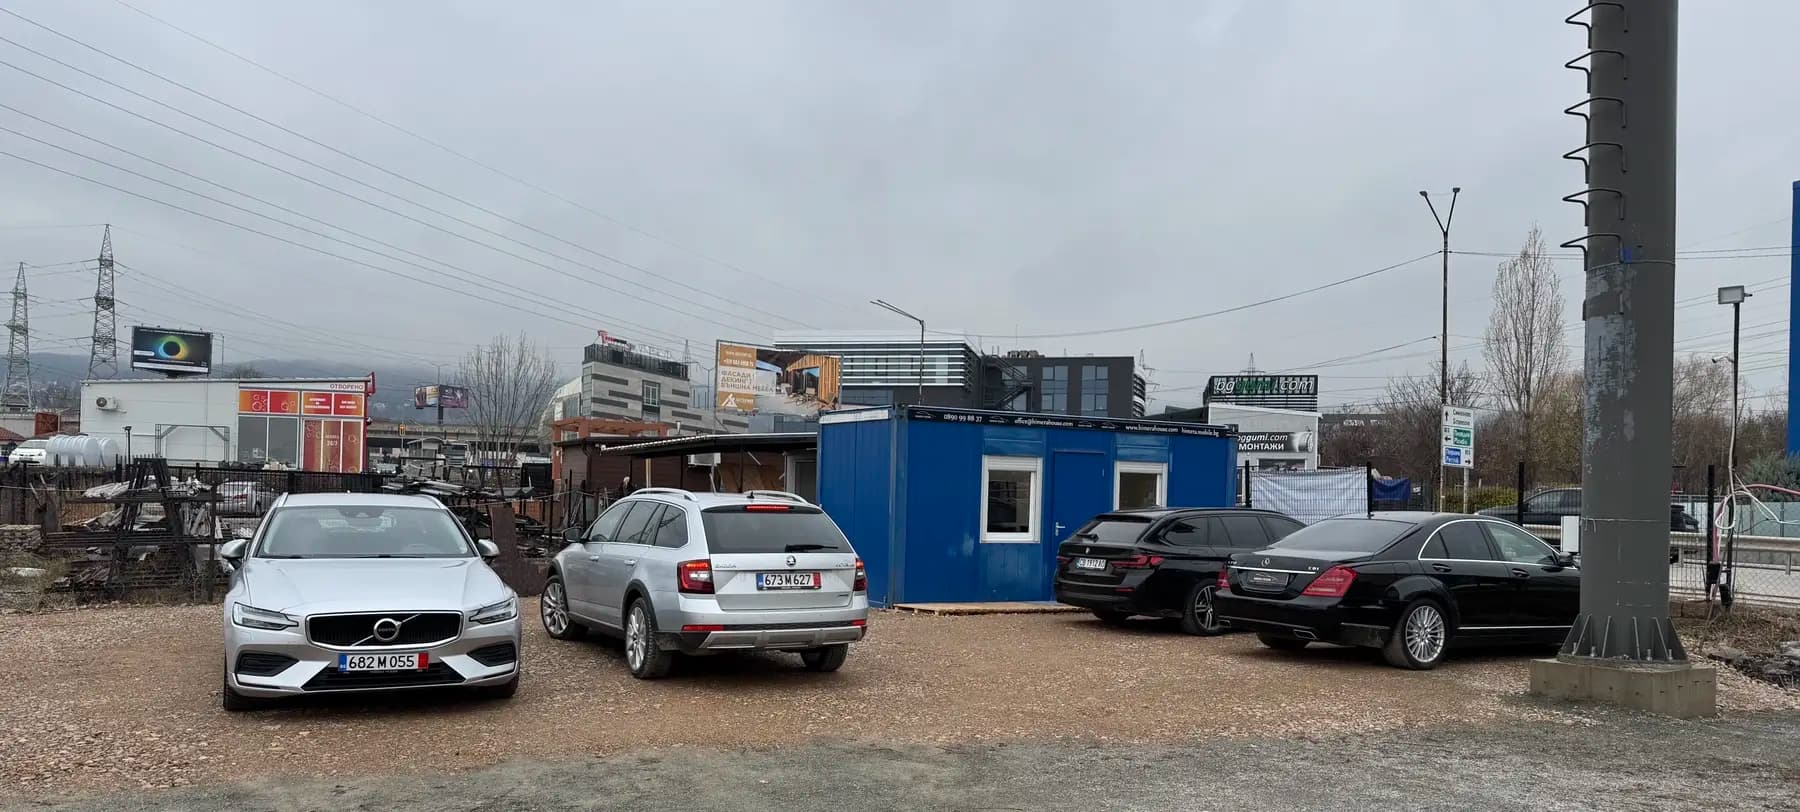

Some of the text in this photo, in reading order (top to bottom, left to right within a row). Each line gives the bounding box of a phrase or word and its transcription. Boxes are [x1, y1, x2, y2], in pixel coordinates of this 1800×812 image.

[764, 574, 811, 586] 673 M 627
[349, 655, 415, 669] 682 M 055
